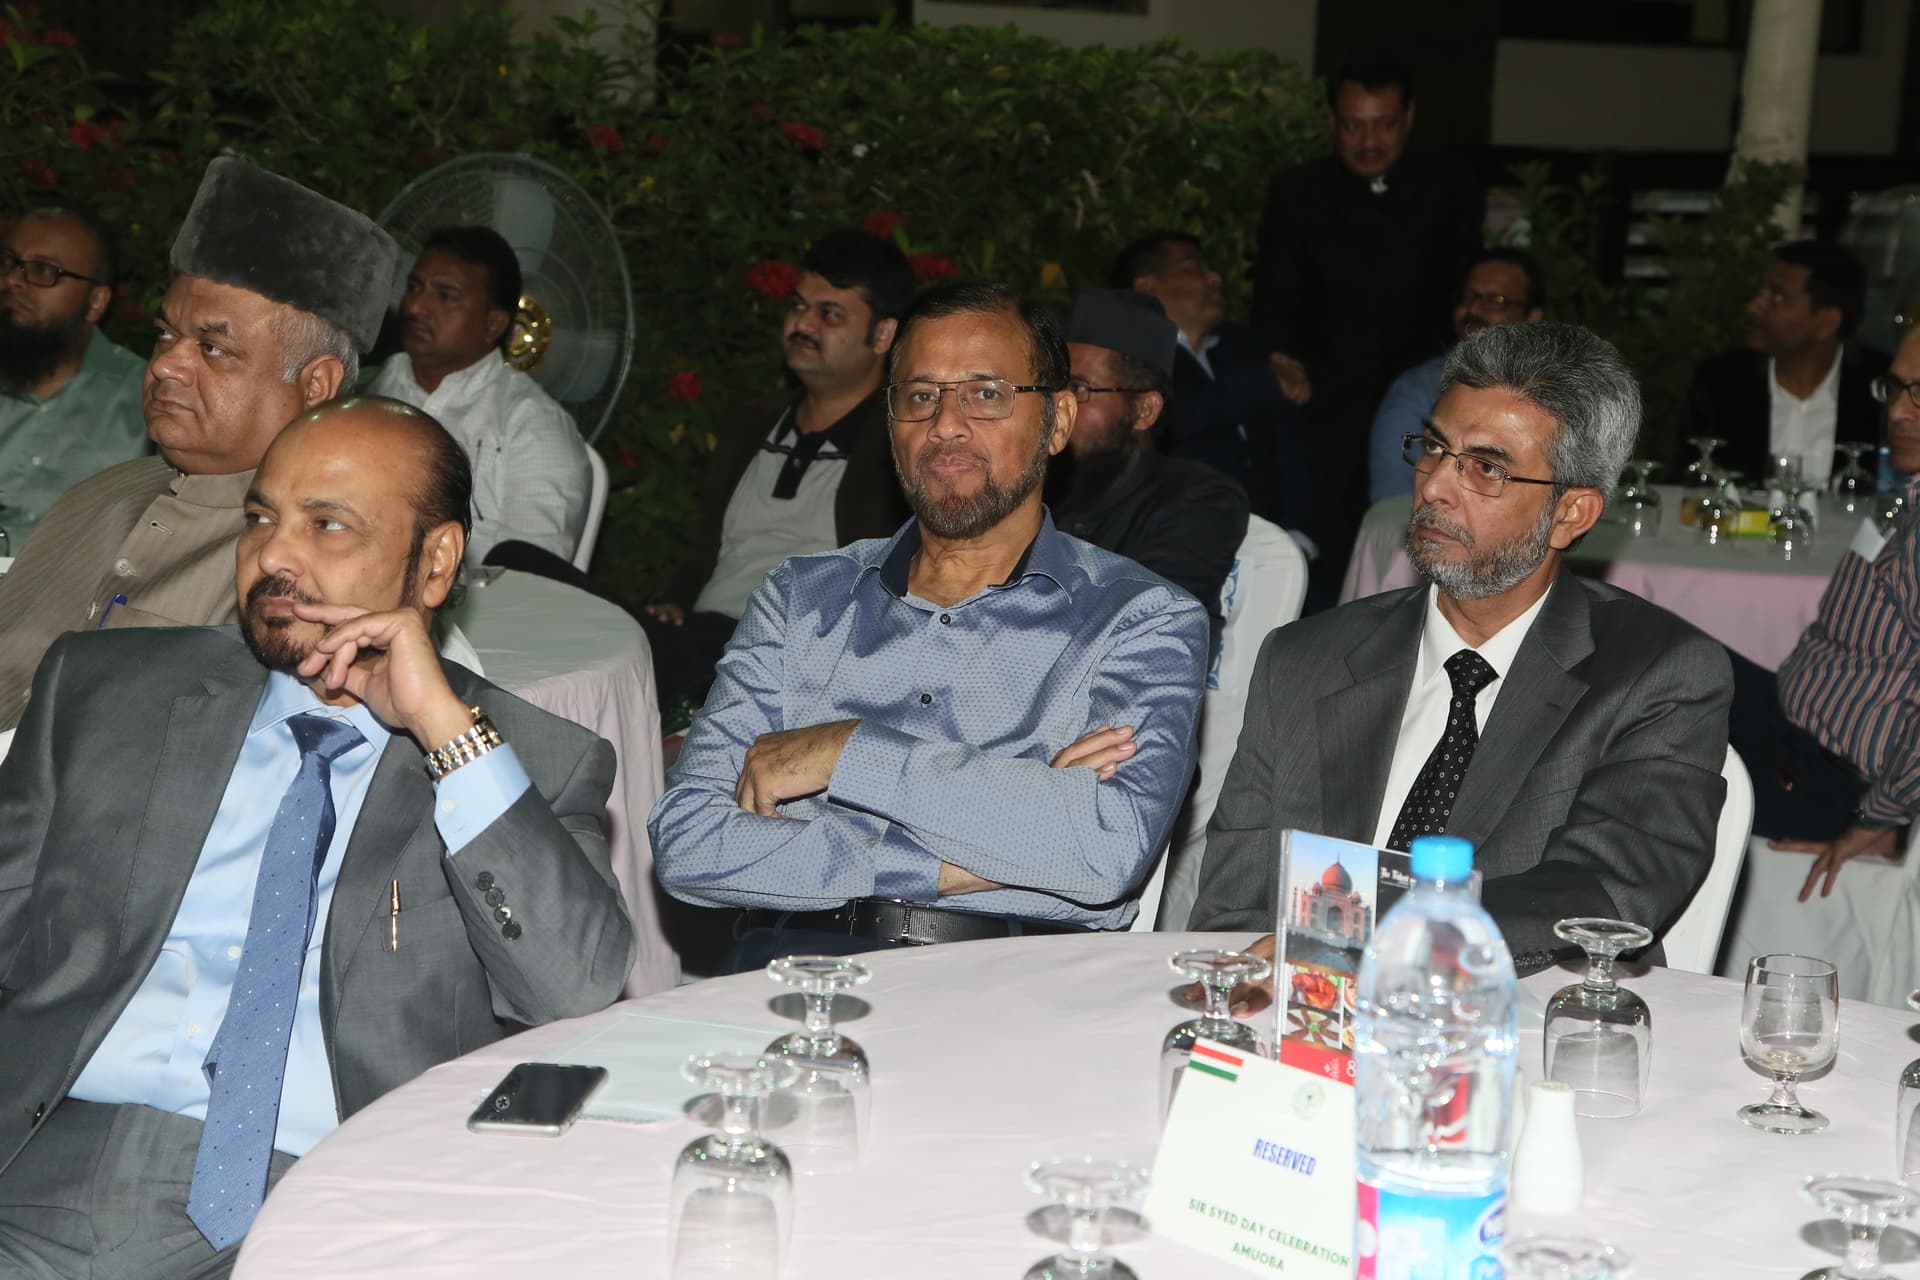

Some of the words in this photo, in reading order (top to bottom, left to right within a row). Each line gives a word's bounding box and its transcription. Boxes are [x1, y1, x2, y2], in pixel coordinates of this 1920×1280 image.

[1254, 1138, 1316, 1175] RESERVED
[1189, 1198, 1206, 1213] SIR
[1209, 1205, 1238, 1225] SYED
[1241, 1217, 1265, 1235] DAY
[1268, 1229, 1350, 1266] CELEBRATION
